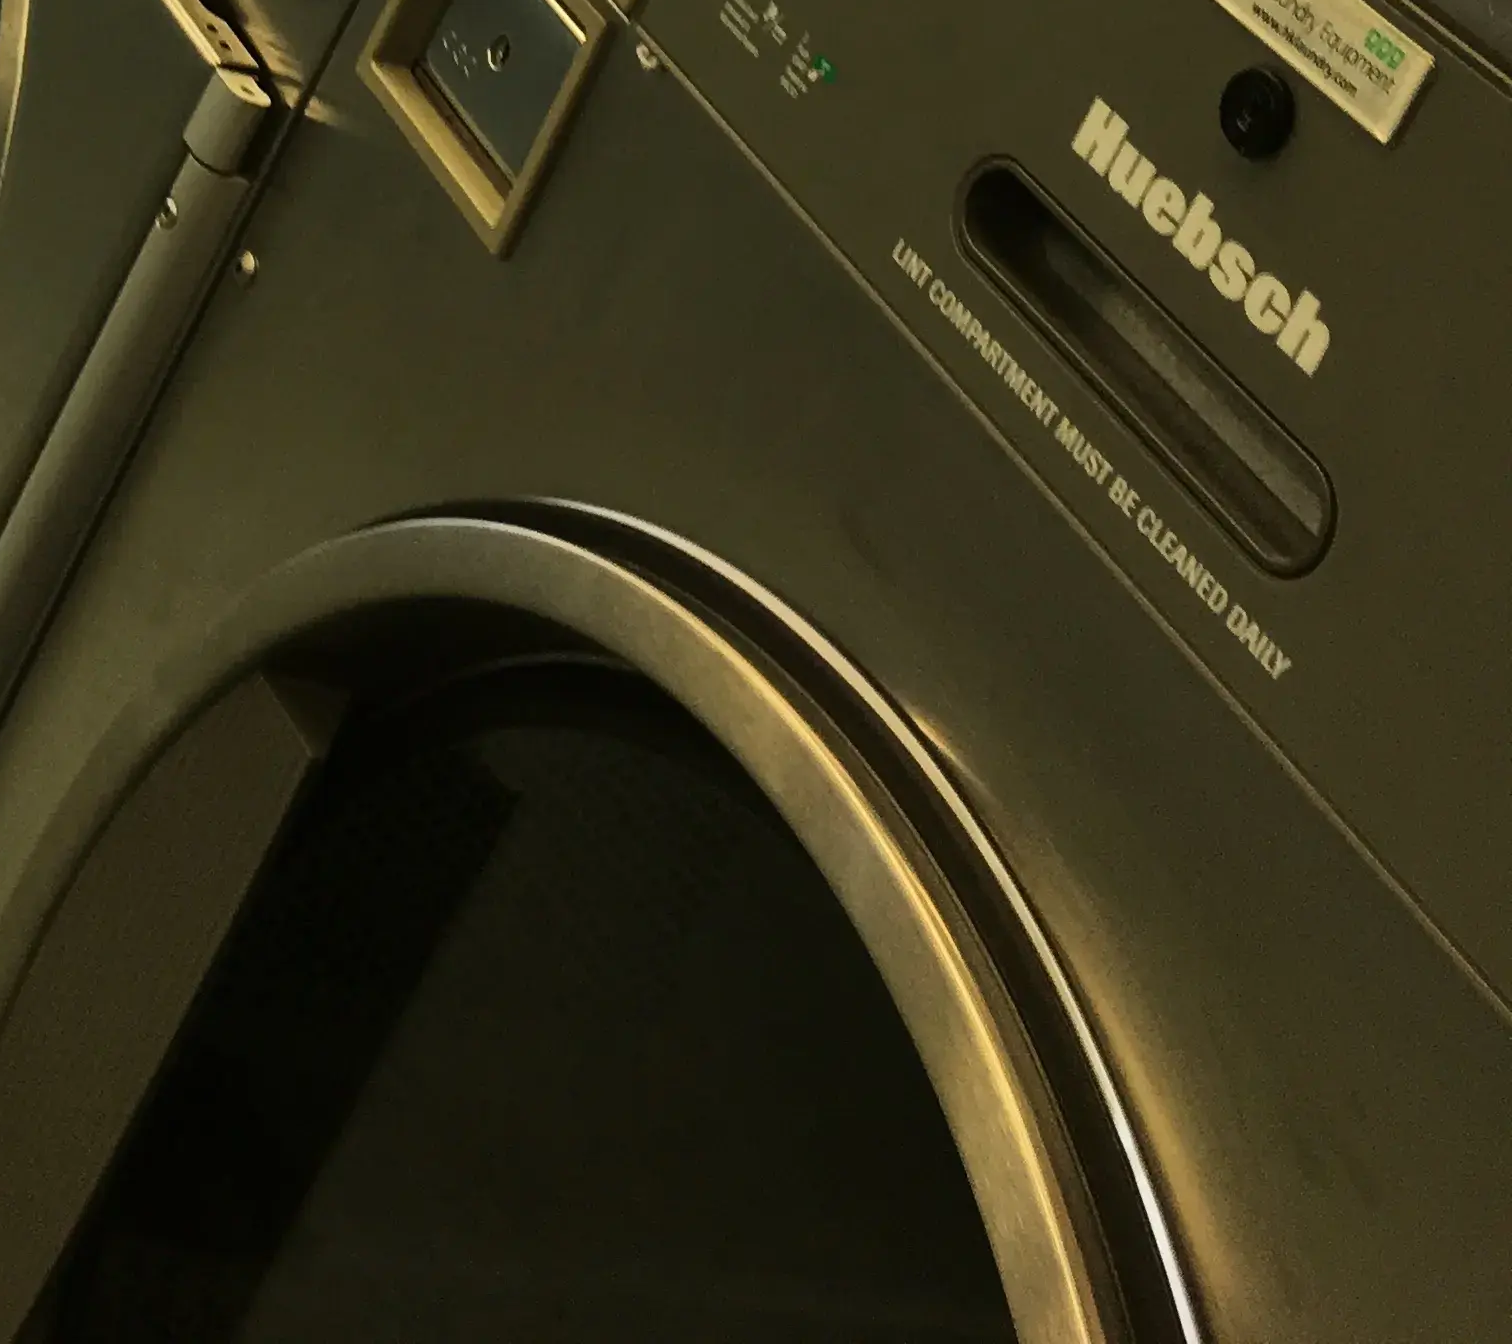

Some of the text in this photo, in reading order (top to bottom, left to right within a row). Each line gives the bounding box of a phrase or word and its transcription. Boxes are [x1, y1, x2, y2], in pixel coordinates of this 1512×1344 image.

[1071, 95, 1330, 378] Huebsch
[892, 237, 1291, 679] LINT COMPARTMENT MUST BE CLEANED DAILY
